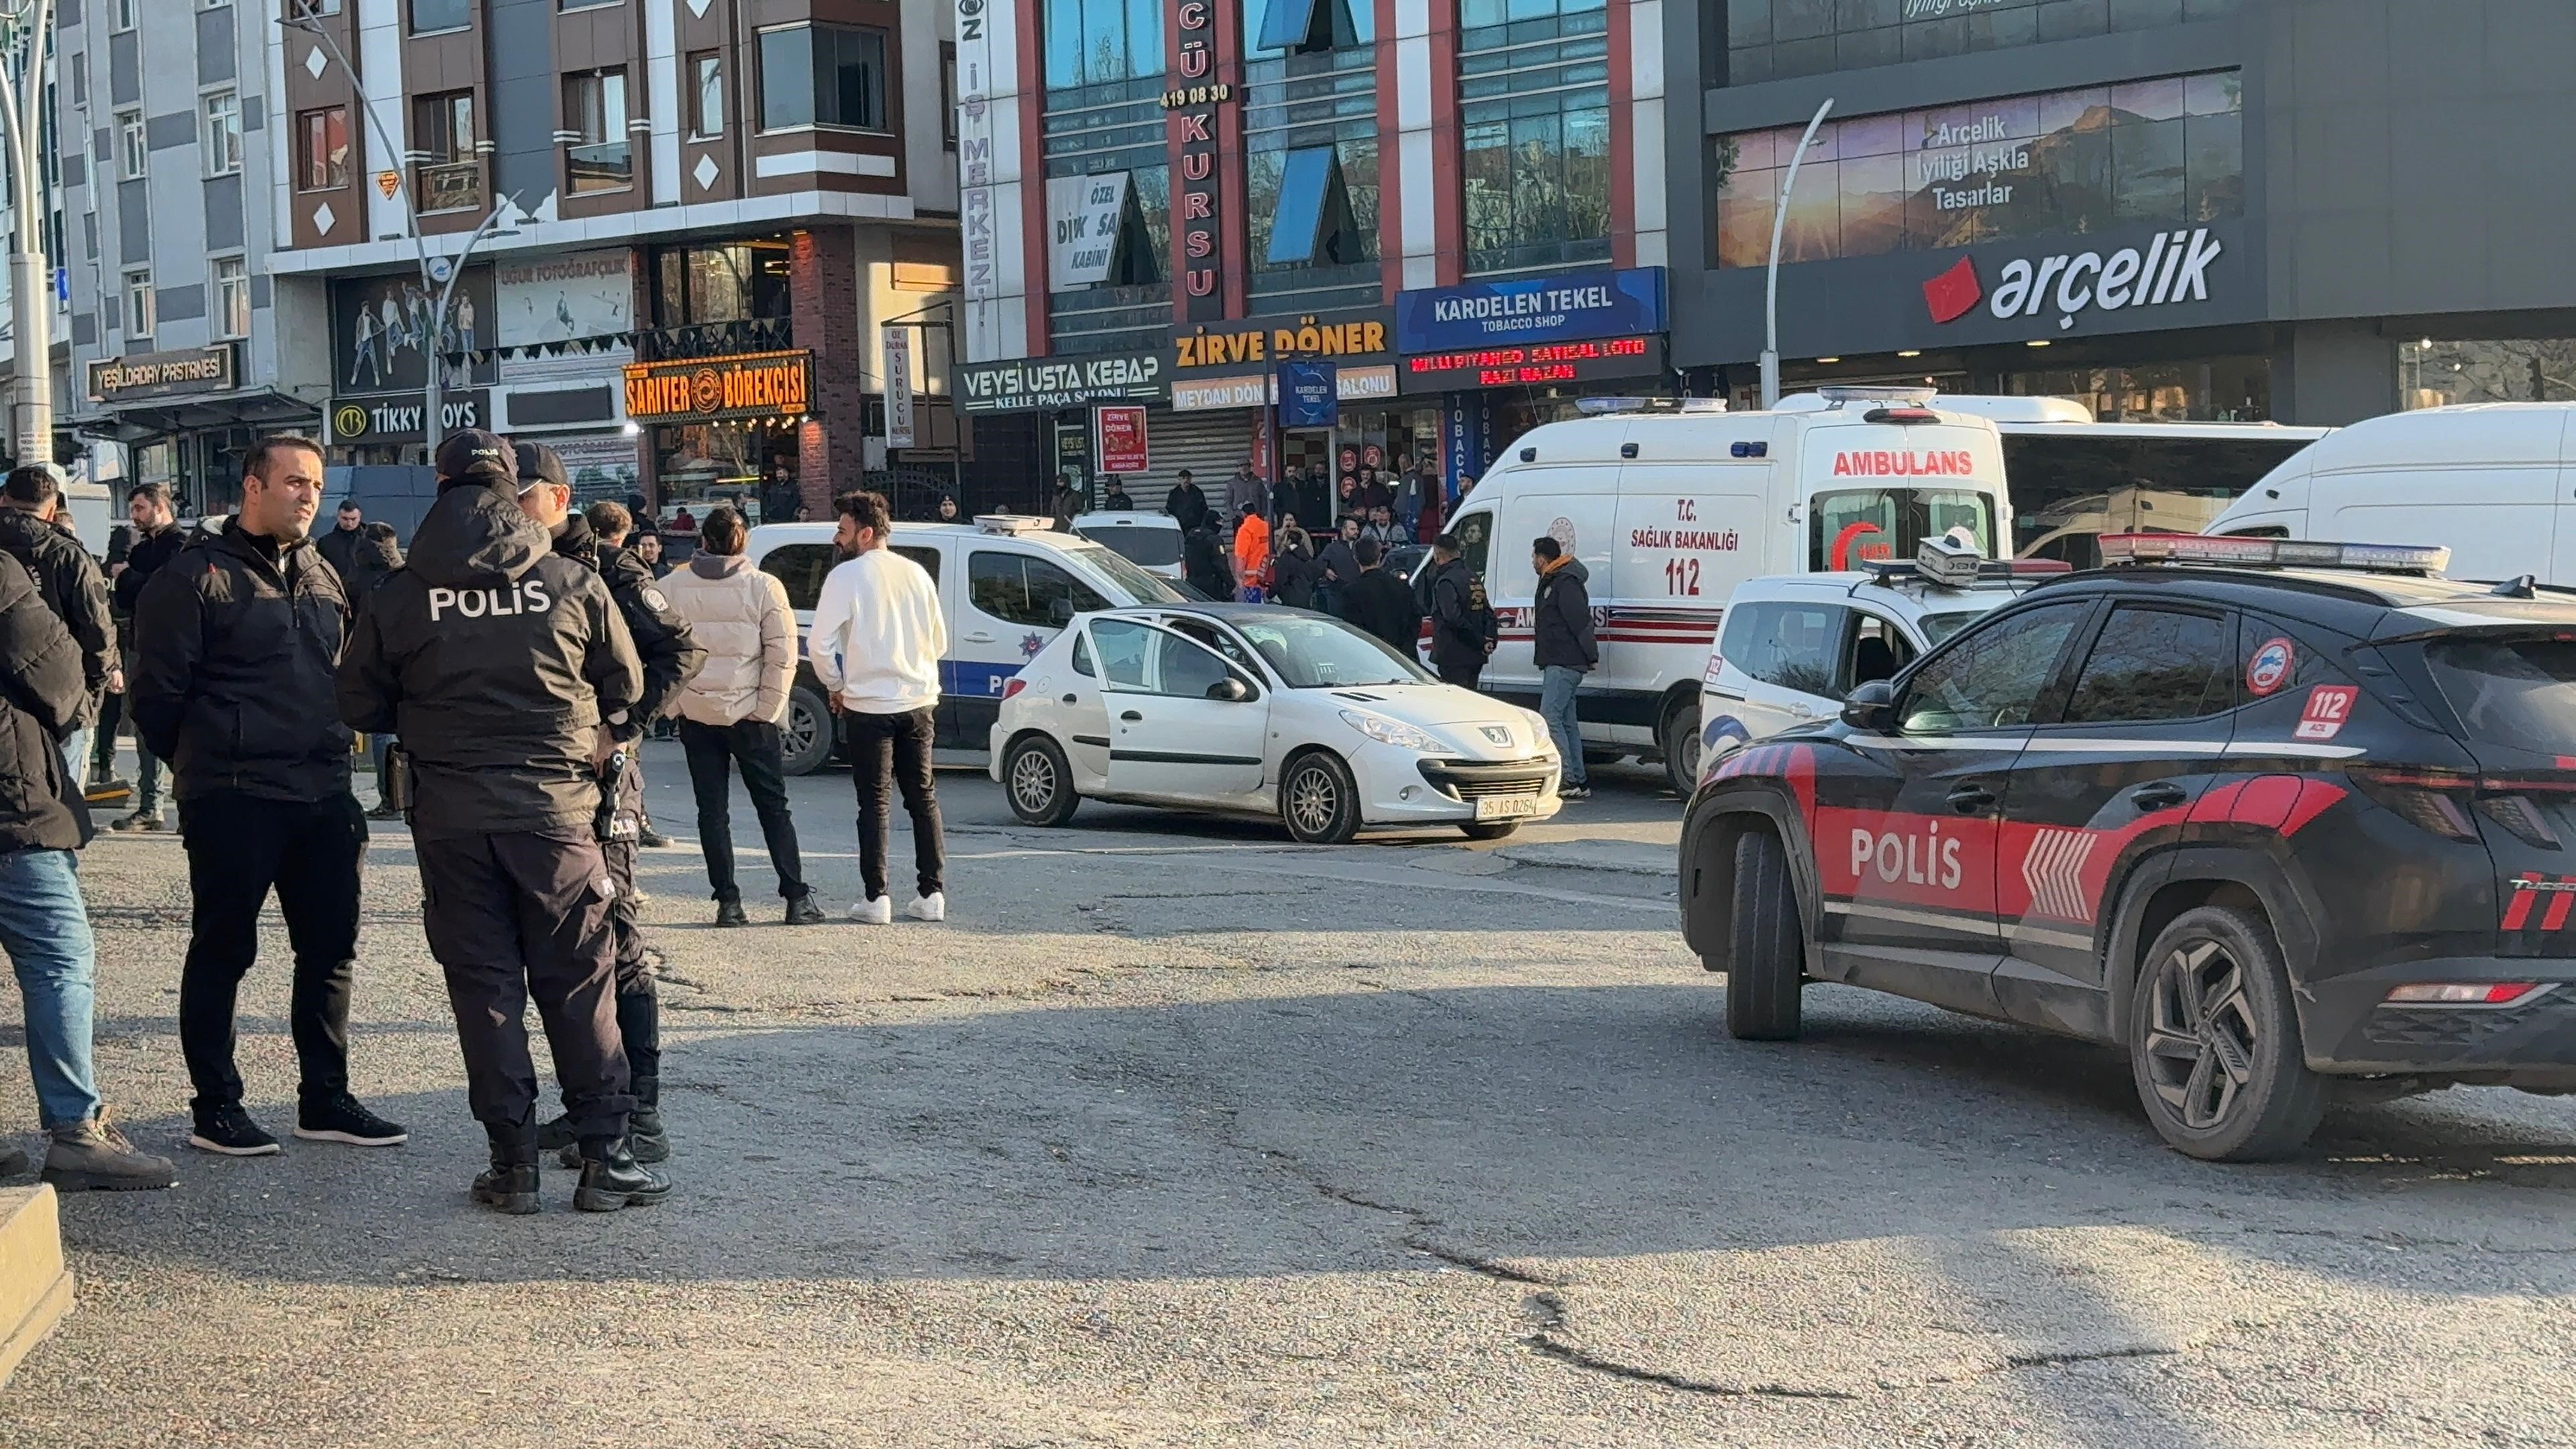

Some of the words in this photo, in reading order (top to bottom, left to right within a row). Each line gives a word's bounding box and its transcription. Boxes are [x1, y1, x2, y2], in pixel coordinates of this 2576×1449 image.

[1160, 89, 1185, 107] 419
[1189, 87, 1207, 104] 08
[1210, 84, 1228, 101] 30
[1937, 115, 2006, 146] Arçelik
[1973, 145, 2029, 178] Aşkla
[1181, 114, 1213, 297] KURSU
[1933, 181, 2012, 211] Tasarlar
[964, 138, 991, 317] MERKEZİ
[1990, 228, 2221, 330] arçelik
[1435, 292, 1542, 322] KARDELEN
[1546, 286, 1613, 312] TEKEL
[1481, 317, 1533, 333] TOBACCO
[1536, 315, 1566, 328] SHOP
[1175, 325, 1265, 367] ZİRVE
[1275, 315, 1386, 359] DÖNER
[162, 352, 221, 382] PASTANESİ
[963, 362, 1023, 397] VEYSİ
[1028, 363, 1082, 392] USTA
[1086, 356, 1159, 387] KEBAP
[627, 376, 690, 416] SARIYER
[724, 358, 806, 409] BÖREKÇİSİ
[996, 396, 1034, 409] KELLE
[1038, 392, 1071, 407] PAÇA
[1175, 386, 1230, 408] MEYDAN
[372, 402, 421, 433] TİKKY
[441, 401, 476, 429] OYS
[1454, 395, 1464, 496] TOBACC
[1833, 451, 1973, 476] AMBULANS
[1677, 499, 1697, 521] T.C.
[1631, 525, 1672, 548] SAĞLIK
[1675, 528, 1738, 551] BAKANLIĞI
[1666, 558, 1699, 596] 112
[429, 580, 551, 621] POLİS
[2311, 692, 2348, 718] 112
[1483, 801, 1494, 814] 35
[1851, 820, 1961, 890] POLİS
